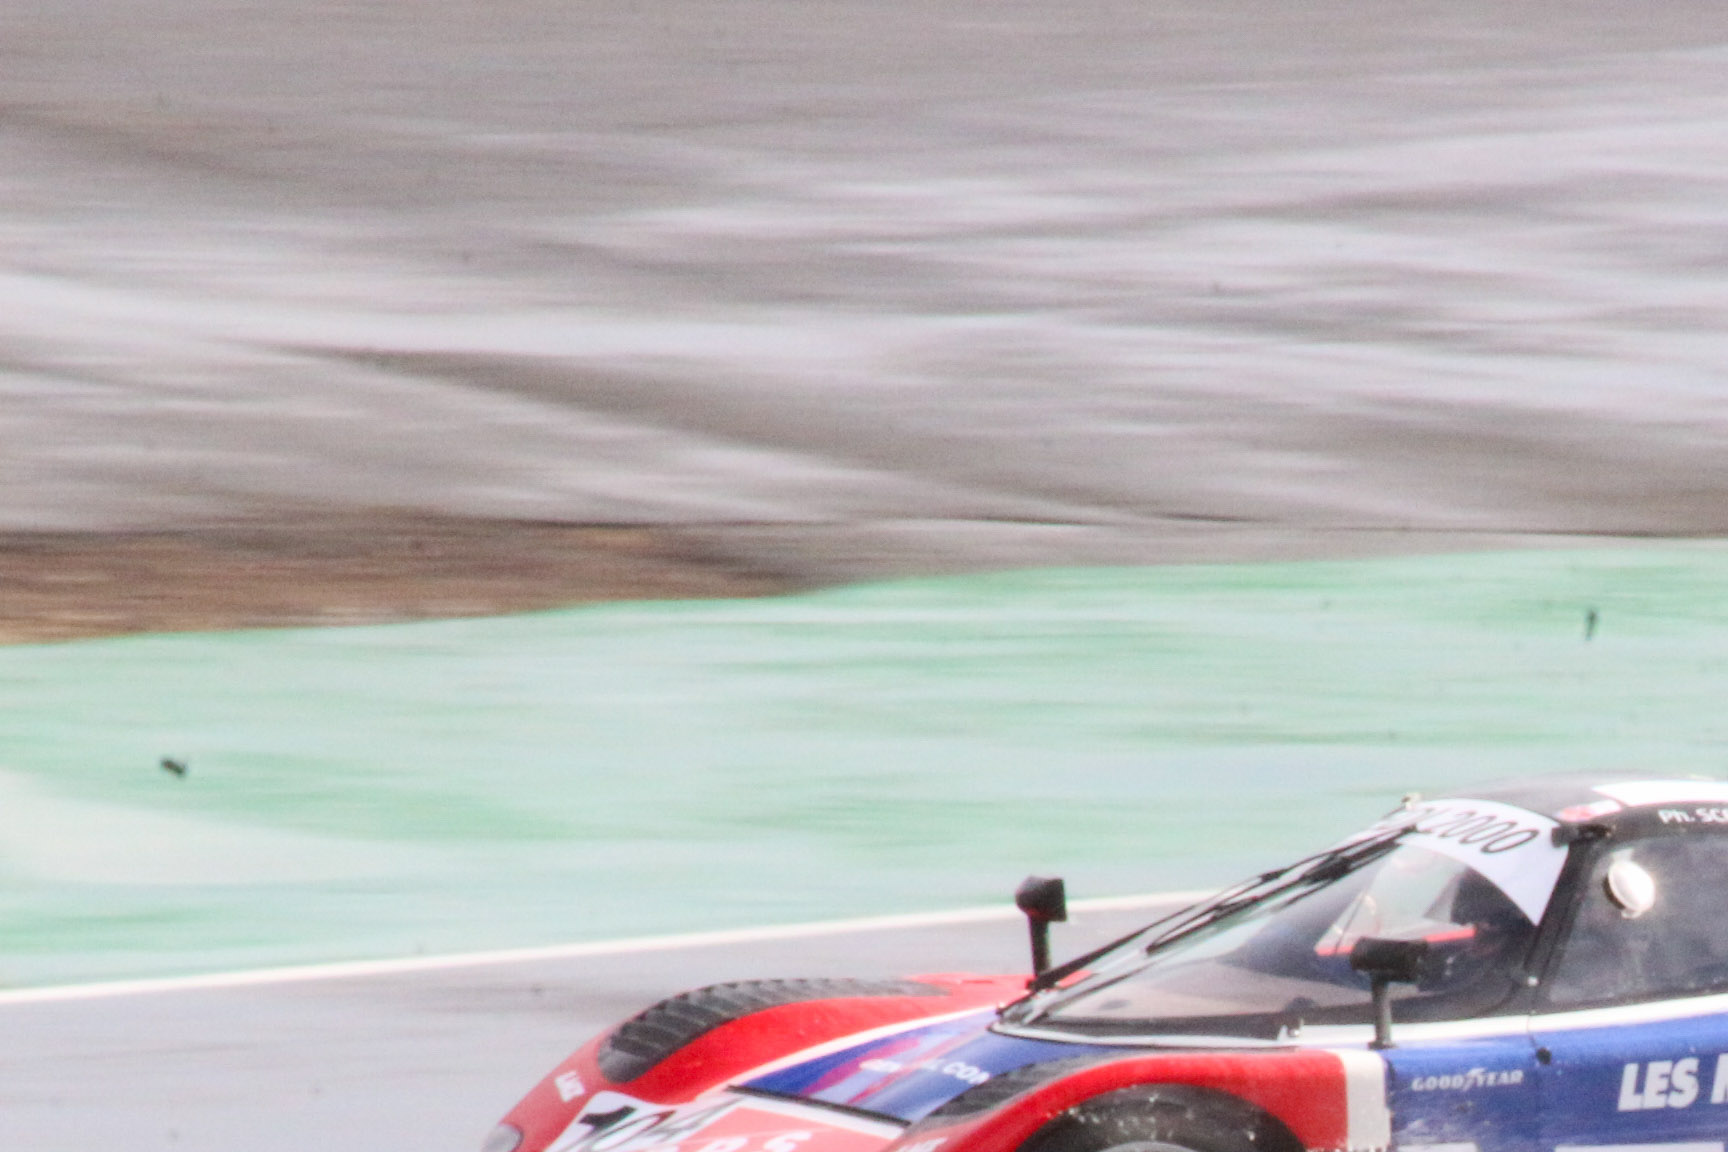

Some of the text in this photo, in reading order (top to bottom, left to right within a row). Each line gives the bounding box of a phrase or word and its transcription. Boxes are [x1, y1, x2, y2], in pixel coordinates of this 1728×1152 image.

[1418, 809, 1540, 854] 2000
[1411, 1067, 1524, 1092] GOODYEAR
[1617, 1057, 1700, 1112] LES
